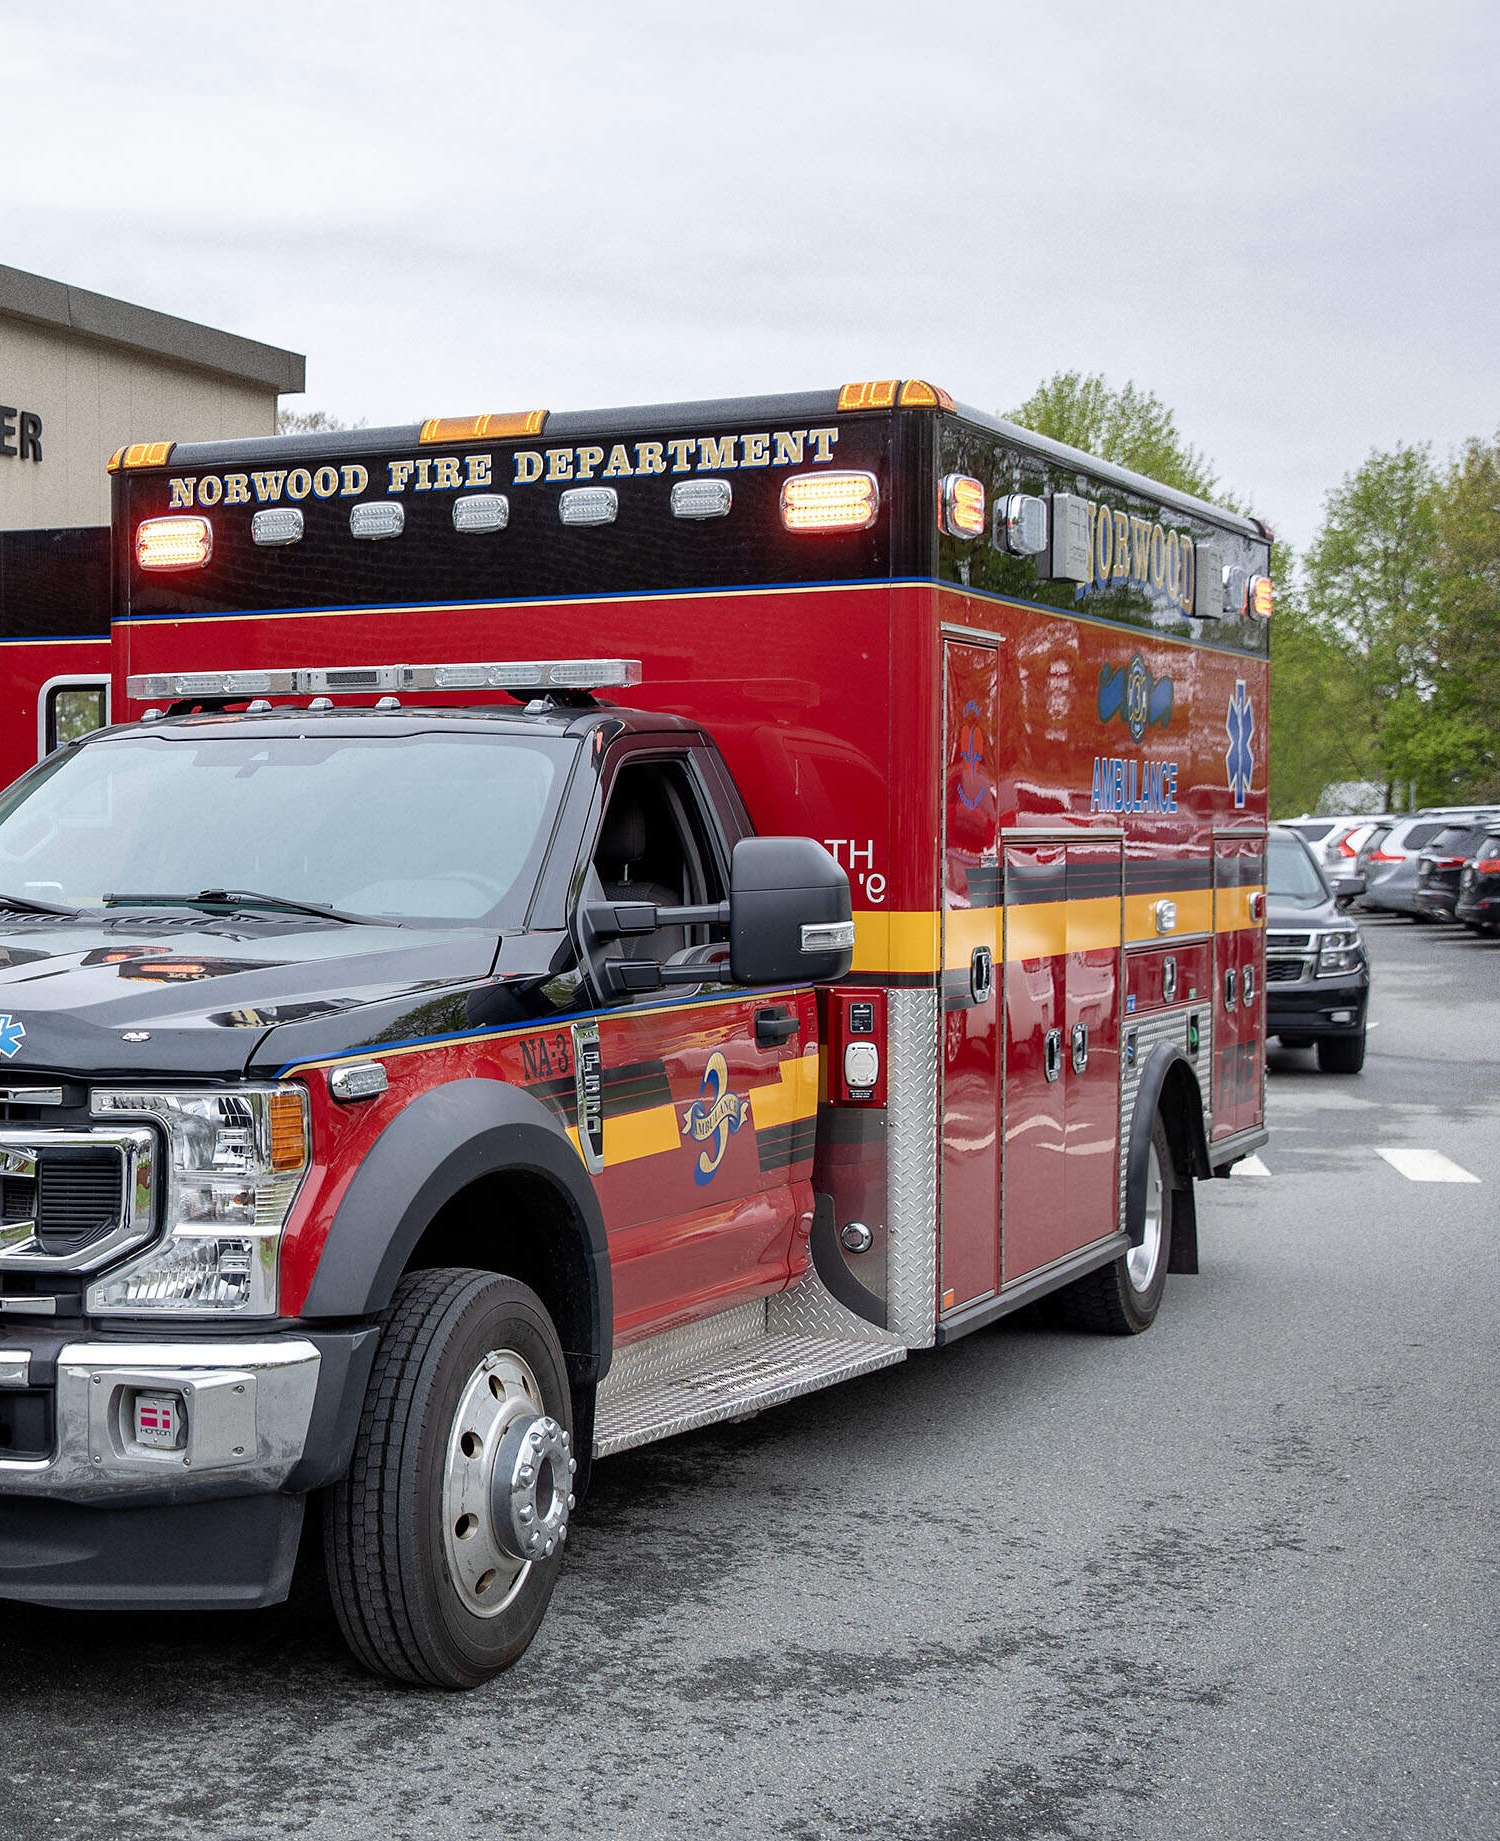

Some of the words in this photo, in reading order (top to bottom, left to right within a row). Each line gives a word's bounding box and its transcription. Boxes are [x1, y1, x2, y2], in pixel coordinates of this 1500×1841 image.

[168, 464, 369, 509] NORWOOD
[388, 454, 493, 494] FIRE
[513, 428, 839, 486] DEPARTMENT
[1091, 757, 1178, 814] AMBULANCE
[1219, 1040, 1255, 1111] FIRE
[694, 1097, 739, 1136] AMBULANCE
[140, 1428, 171, 1436] Horton
